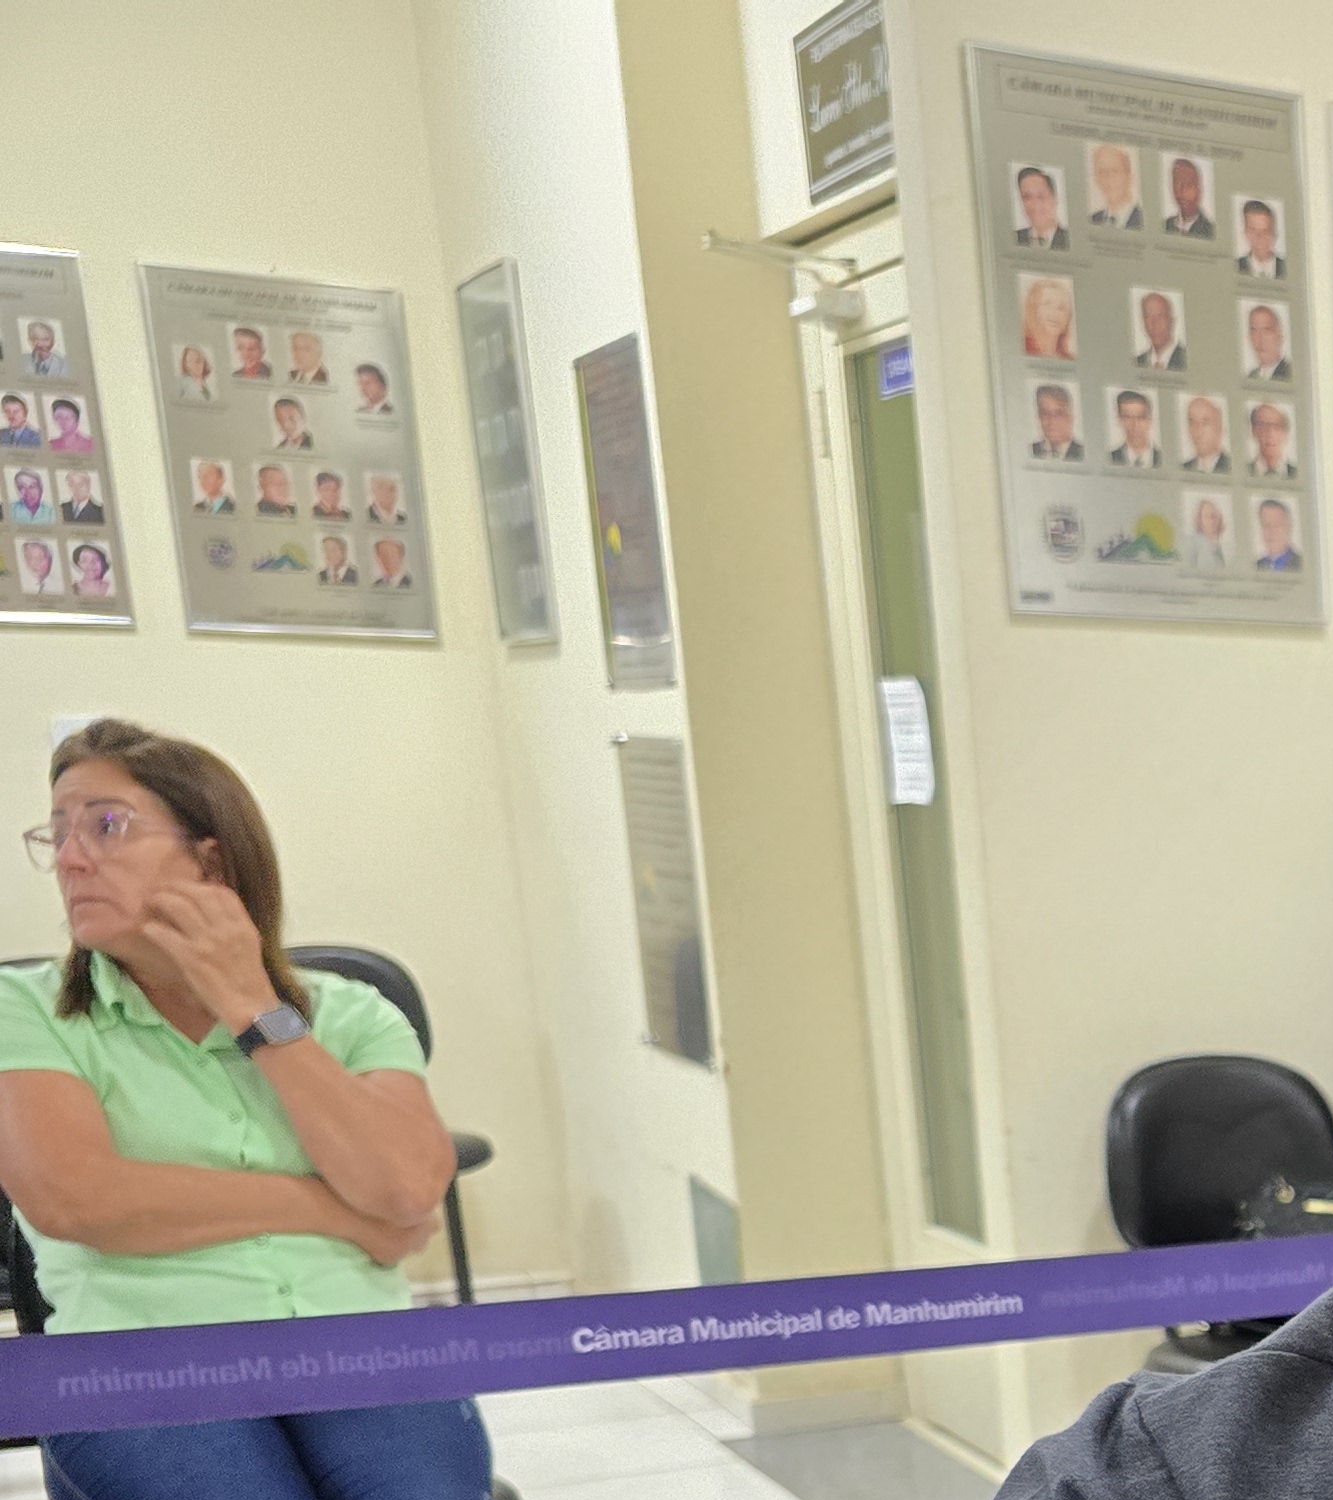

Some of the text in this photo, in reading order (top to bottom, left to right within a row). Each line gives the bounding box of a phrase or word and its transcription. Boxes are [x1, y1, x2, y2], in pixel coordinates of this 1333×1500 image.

[571, 1293, 1024, 1354] Câmara Municipal de Manhumirim
